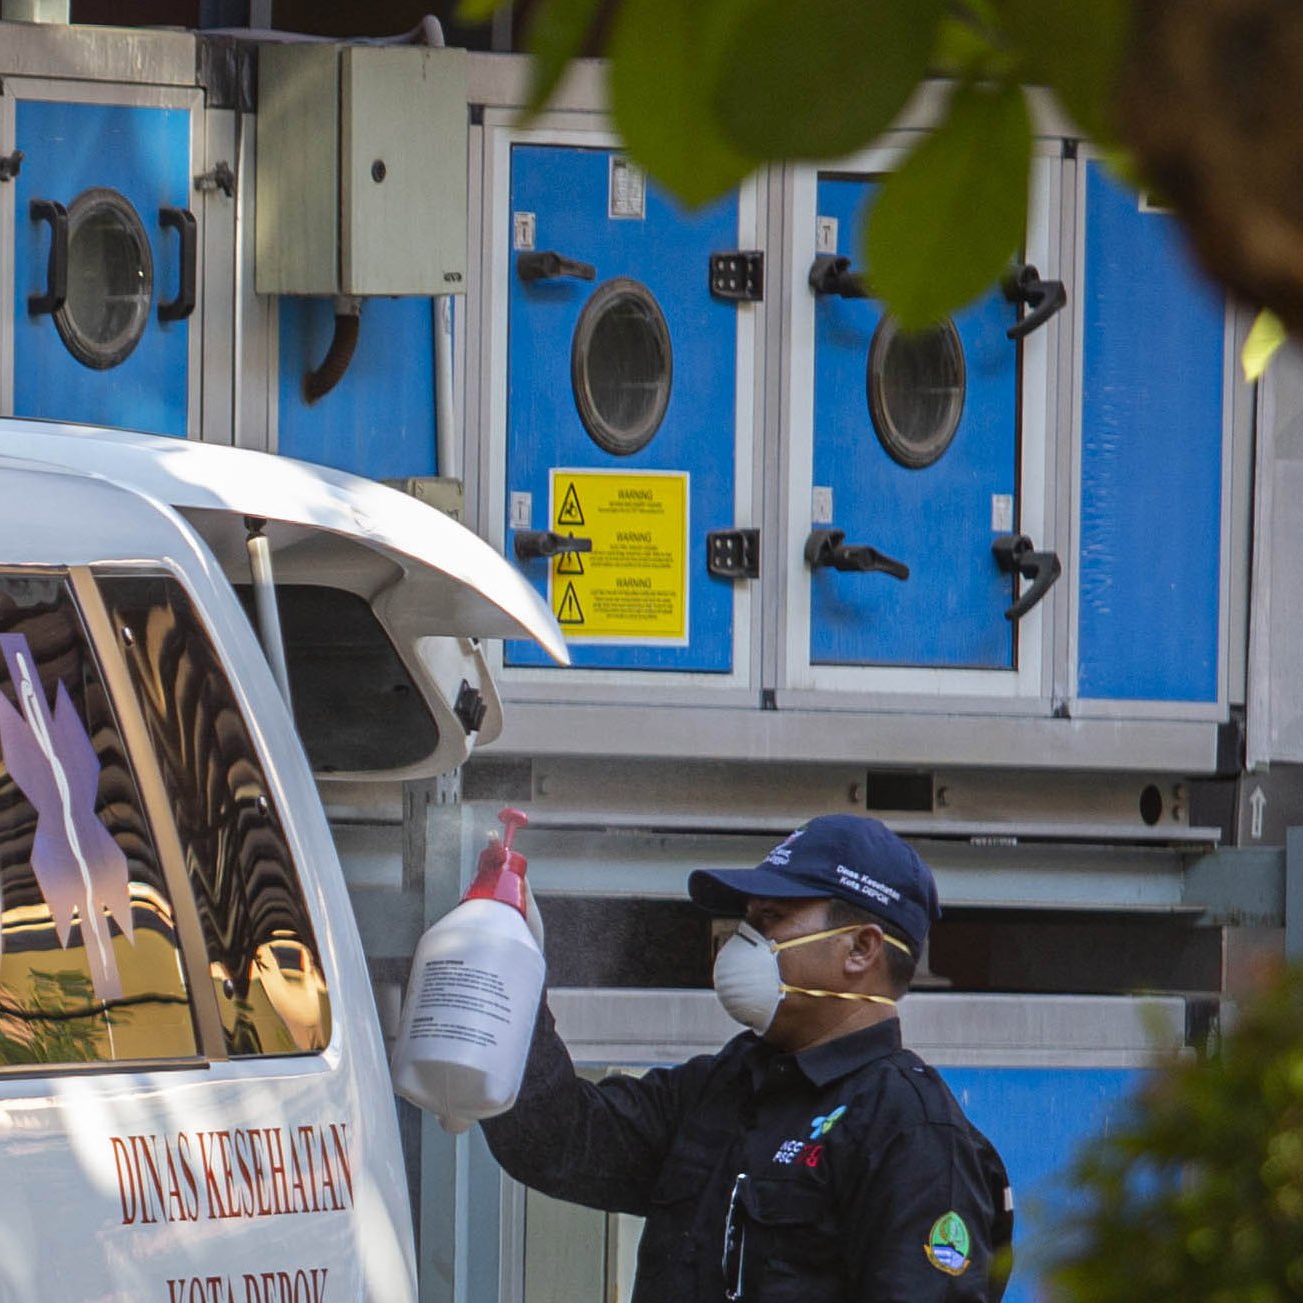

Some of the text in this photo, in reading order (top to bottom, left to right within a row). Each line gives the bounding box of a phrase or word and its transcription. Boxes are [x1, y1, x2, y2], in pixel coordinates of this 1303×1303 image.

[618, 489, 653, 500] WARNING
[616, 532, 652, 542] WARNING
[615, 578, 652, 588] WARNING
[836, 864, 900, 901] Dinas Kesehatan
[839, 876, 860, 891] Kota
[111, 1122, 353, 1226] DINAS KESEHATAN
